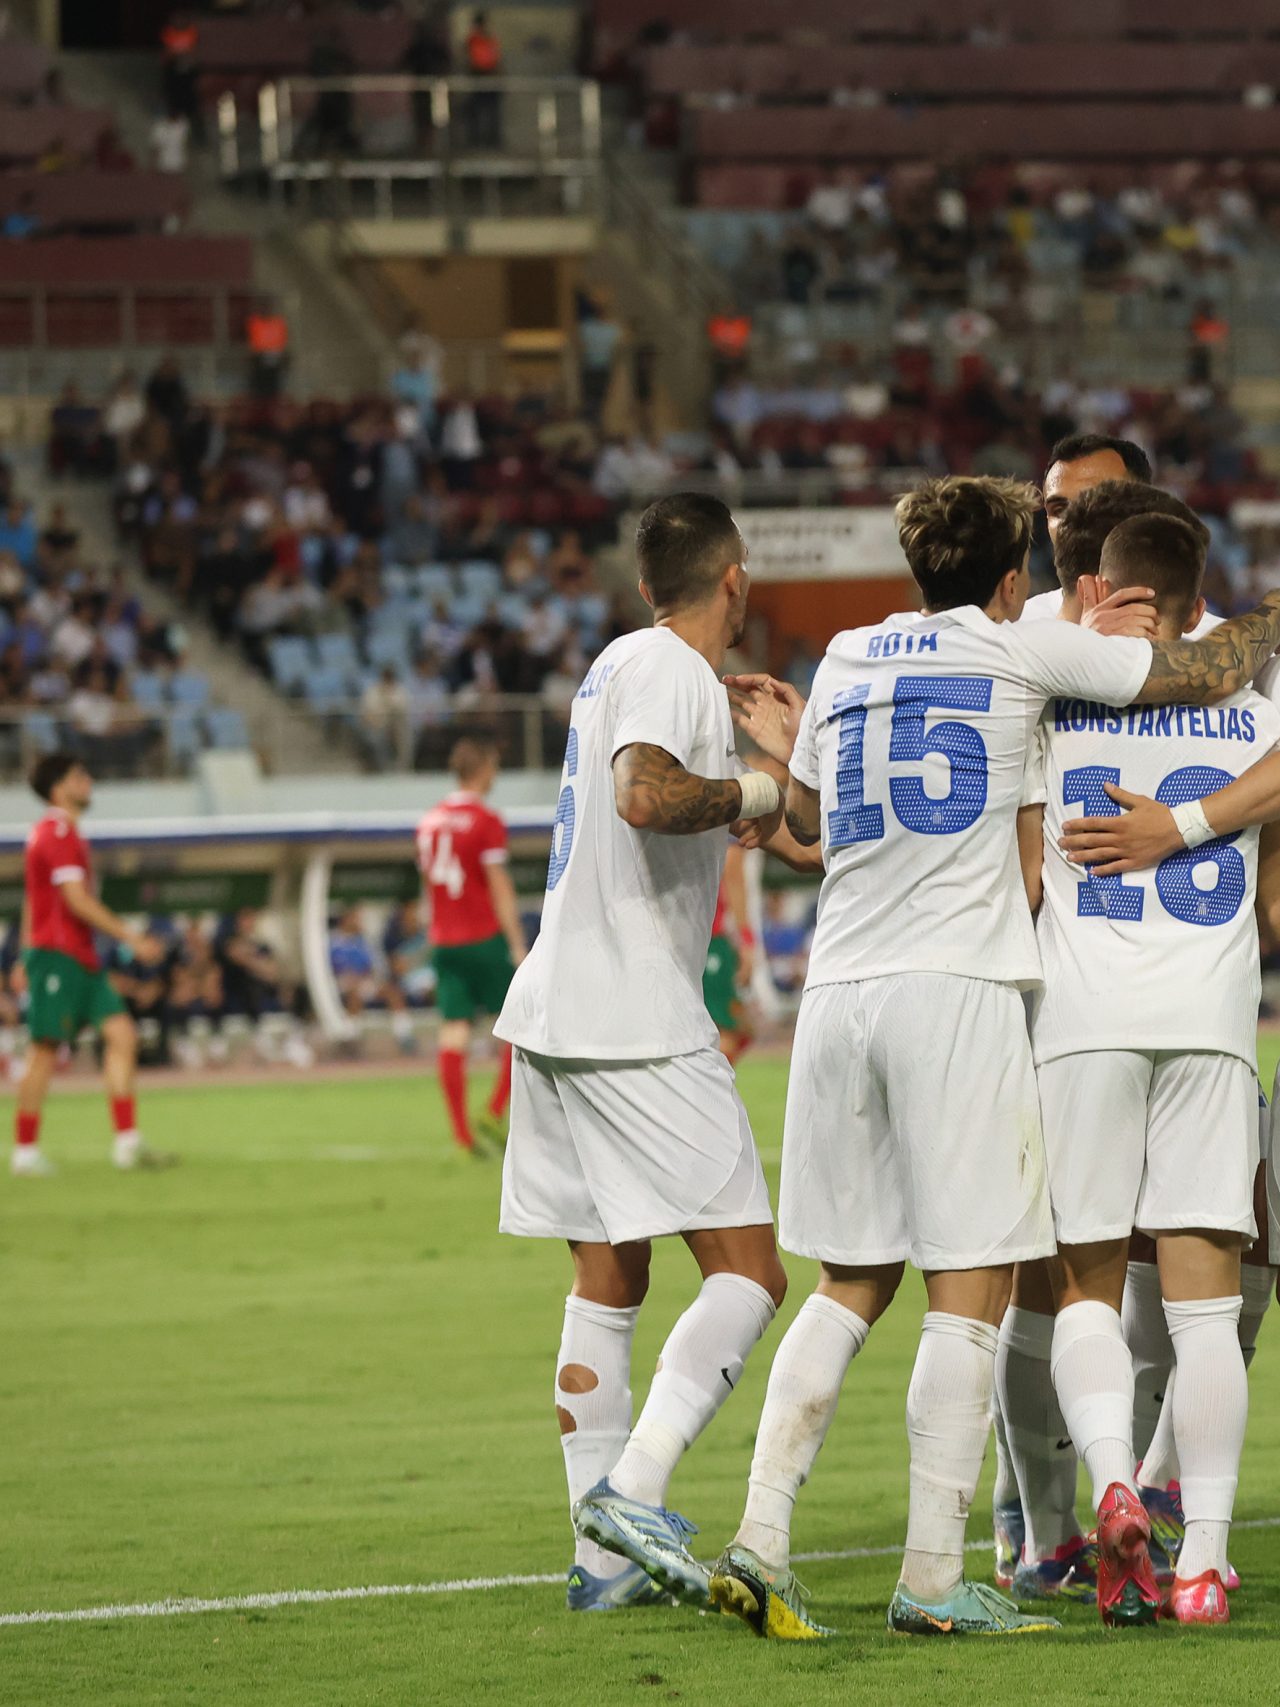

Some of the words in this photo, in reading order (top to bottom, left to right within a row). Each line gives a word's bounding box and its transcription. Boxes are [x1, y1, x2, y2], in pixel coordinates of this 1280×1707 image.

[827, 676, 993, 847] 15
[1054, 700, 1256, 743] KONSTANTELIAS
[1063, 765, 1246, 926] 18
